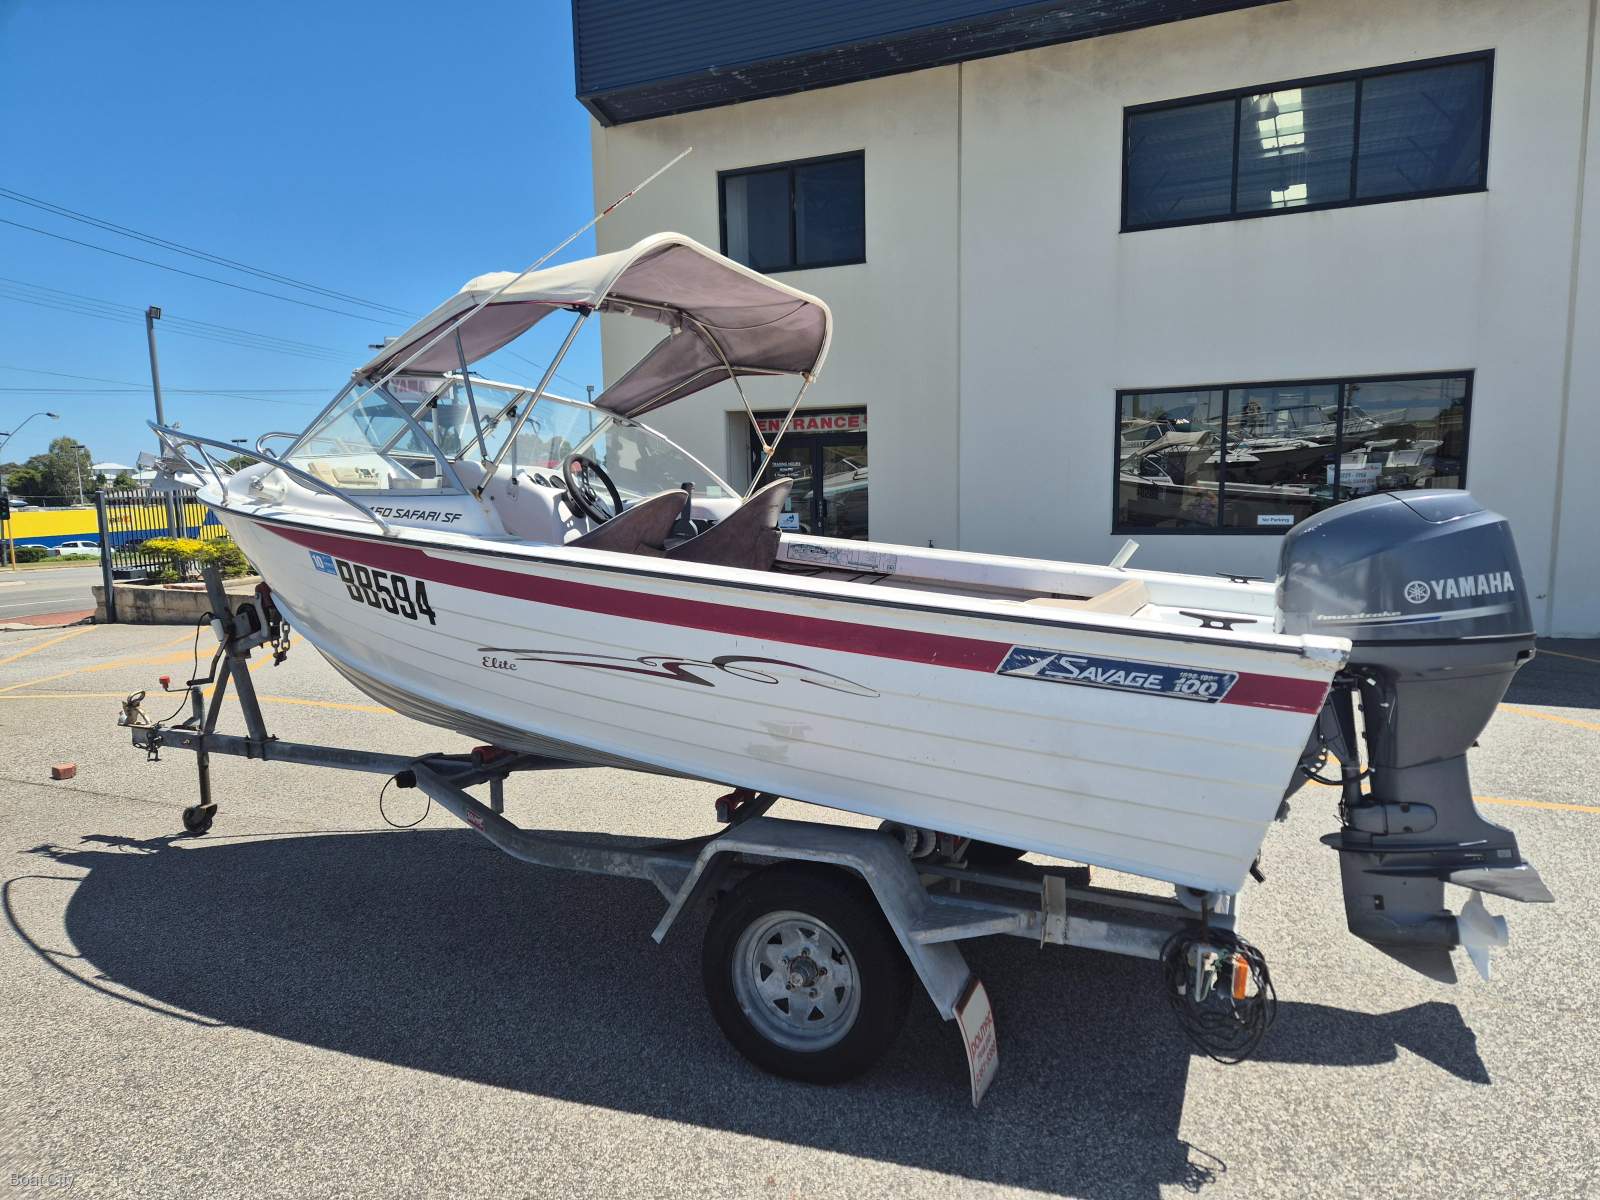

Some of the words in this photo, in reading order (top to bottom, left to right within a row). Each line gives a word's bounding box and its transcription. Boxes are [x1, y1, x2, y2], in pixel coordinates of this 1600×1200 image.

[758, 415, 860, 432] ENRANCE
[393, 508, 441, 522] SAFARI
[441, 512, 463, 523] SF
[1430, 571, 1515, 601] YAMAHA
[482, 655, 518, 671] Elite
[1044, 656, 1163, 689] SAVAGE
[1173, 677, 1219, 697] 100
